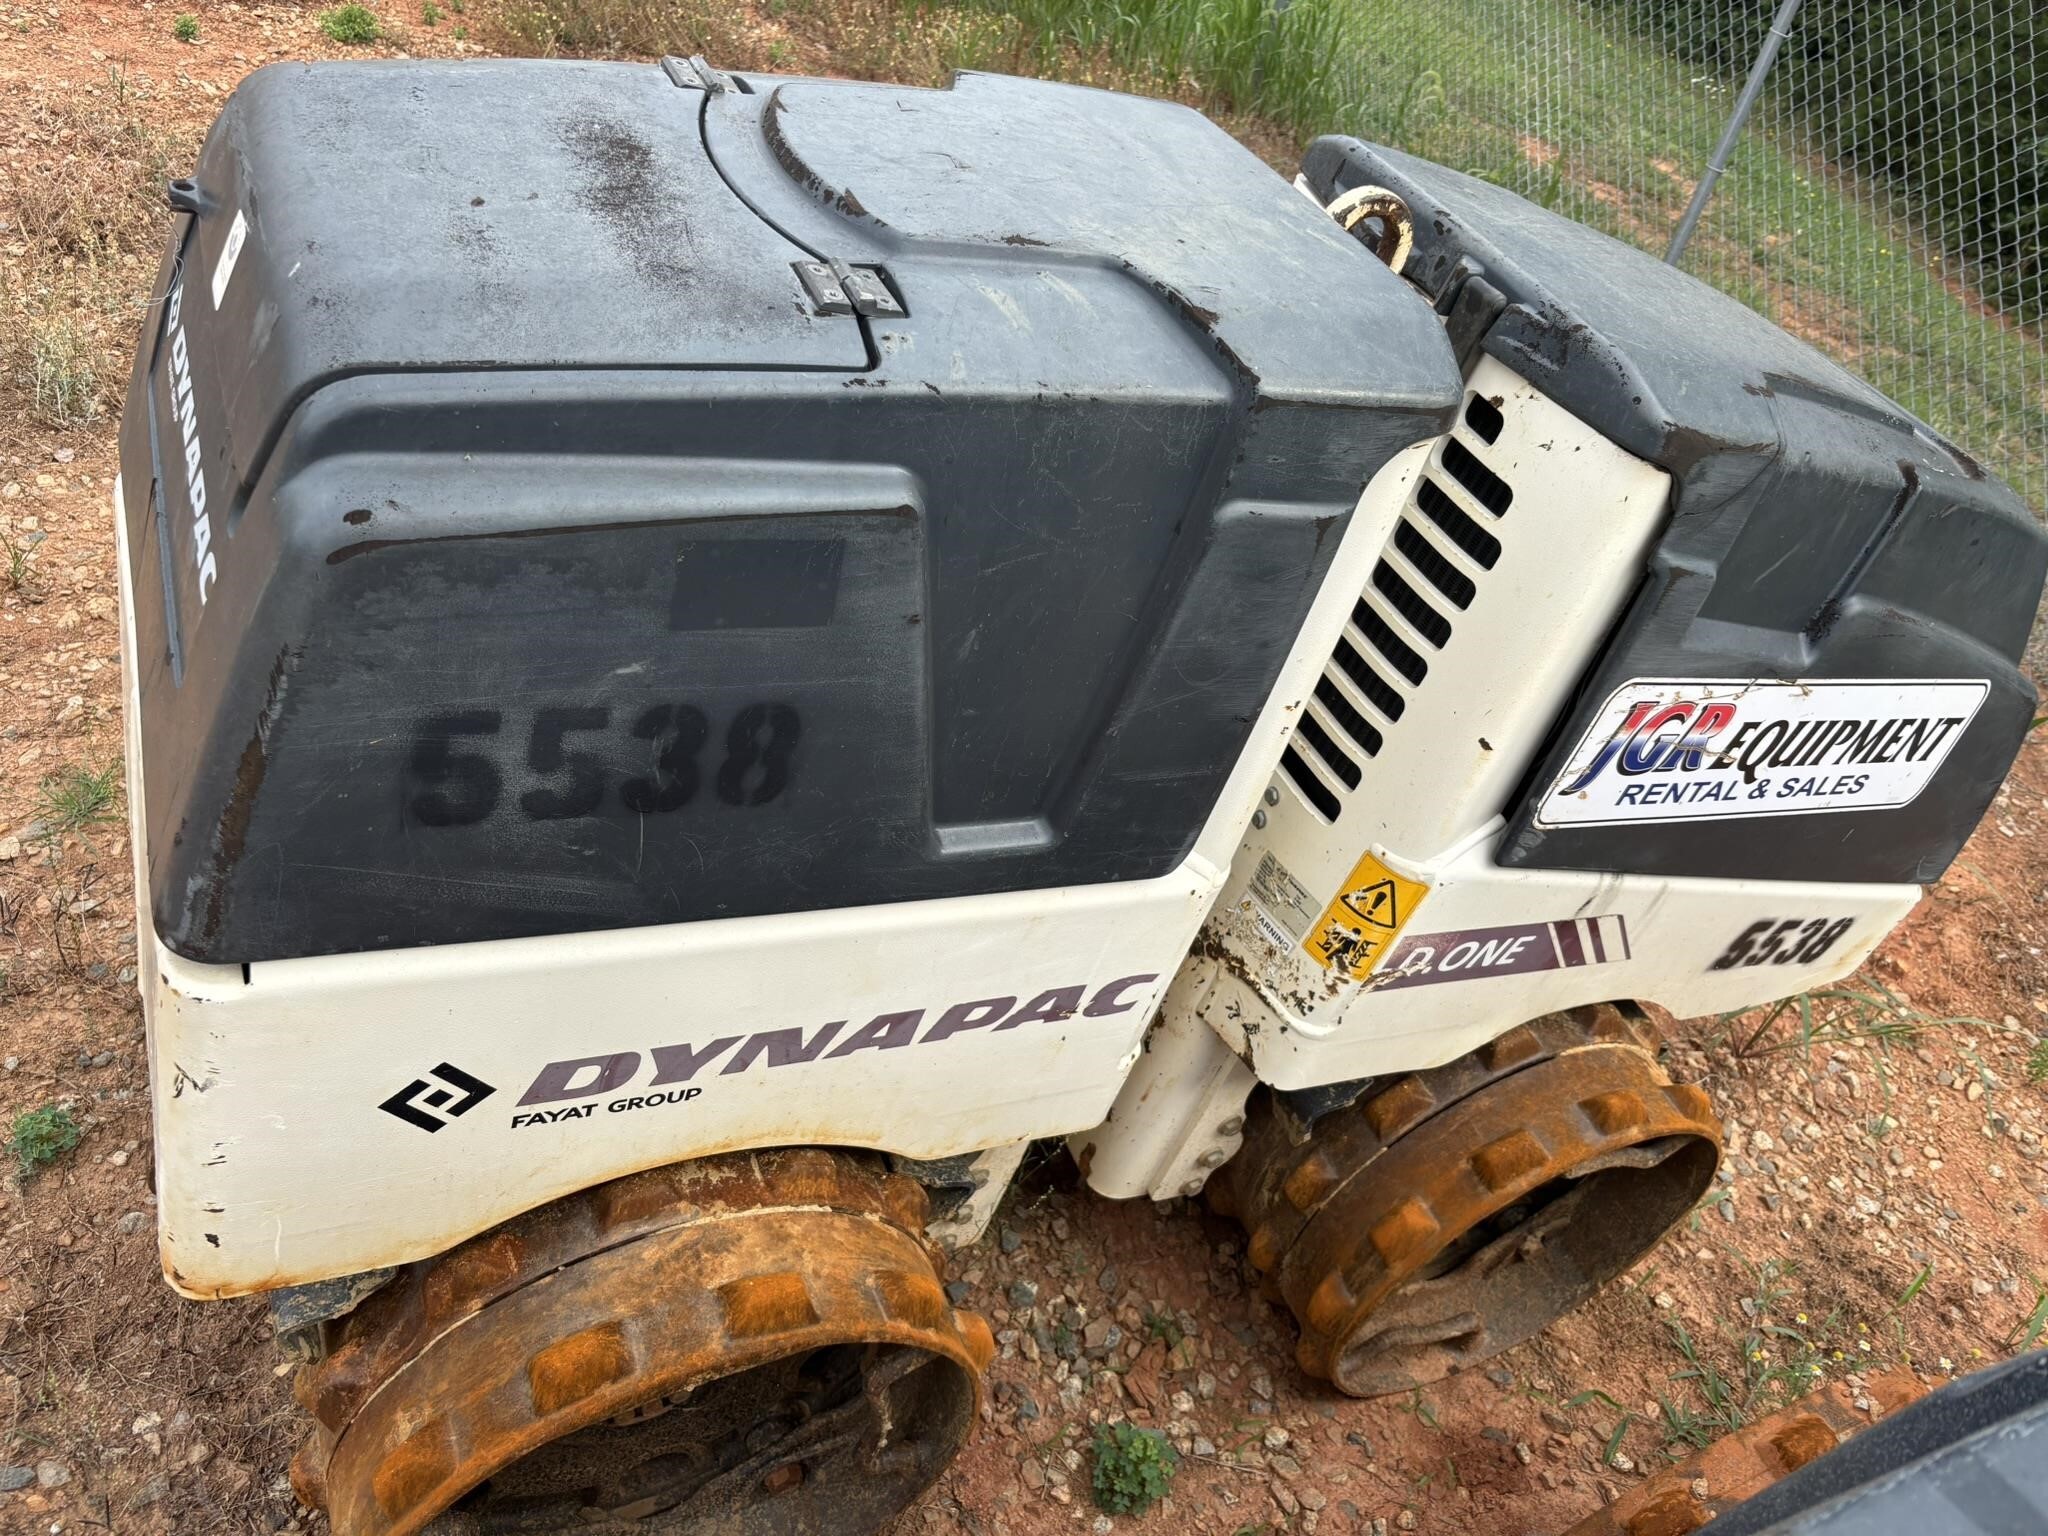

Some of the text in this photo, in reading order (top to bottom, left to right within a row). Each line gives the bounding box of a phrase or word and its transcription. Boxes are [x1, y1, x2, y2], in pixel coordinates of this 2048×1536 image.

[172, 325, 217, 605] DYNAPAC
[409, 702, 801, 827] 5538
[1558, 701, 1966, 796] JGR EQUIPMENT
[1615, 774, 1870, 806] RENTAL & SALES
[1707, 916, 1855, 972] 5538
[515, 974, 1159, 1107] DYNAPAC
[511, 1087, 703, 1129] FAYAT GROUP
